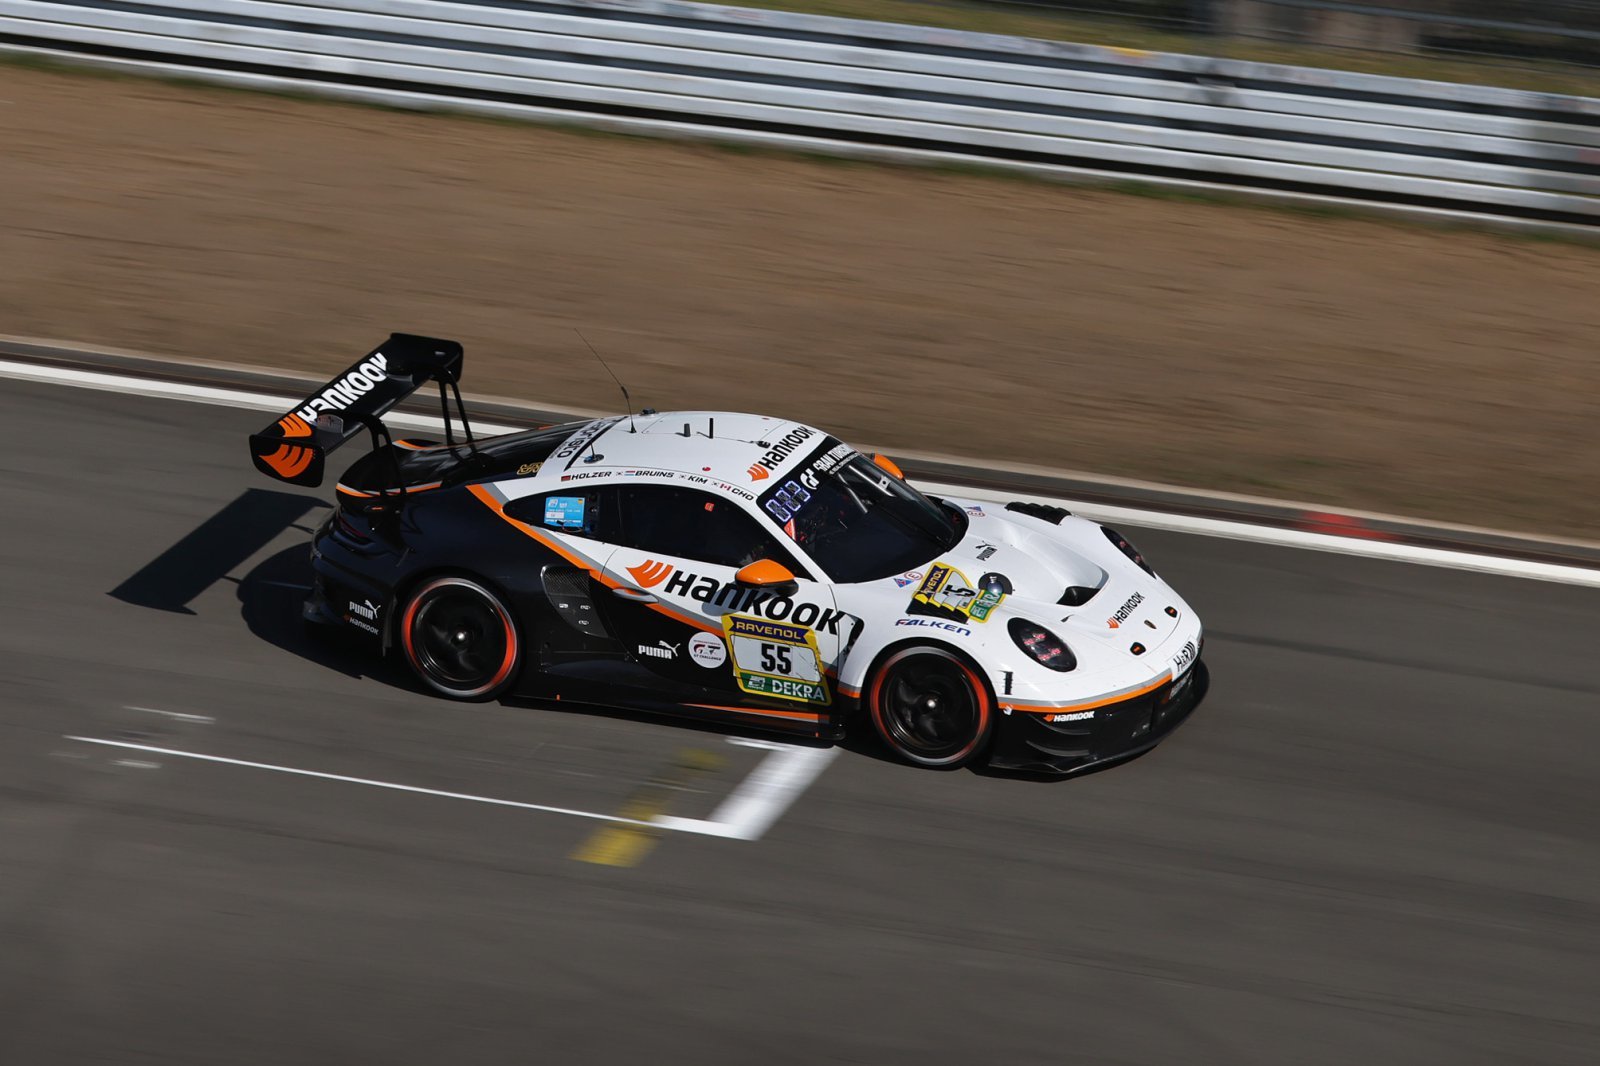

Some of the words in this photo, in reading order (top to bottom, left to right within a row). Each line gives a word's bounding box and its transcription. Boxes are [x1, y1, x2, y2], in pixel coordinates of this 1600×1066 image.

[571, 471, 612, 481] HOLZER
[635, 470, 675, 478] BRUINS
[688, 475, 708, 484] KIM
[731, 488, 755, 501] CHO
[349, 601, 374, 620] PUMA
[735, 621, 801, 640] RAVENOL
[895, 618, 971, 637] FALKEN
[638, 644, 672, 660] PUMA
[761, 642, 792, 675] 55
[771, 679, 825, 701] DEKRA
